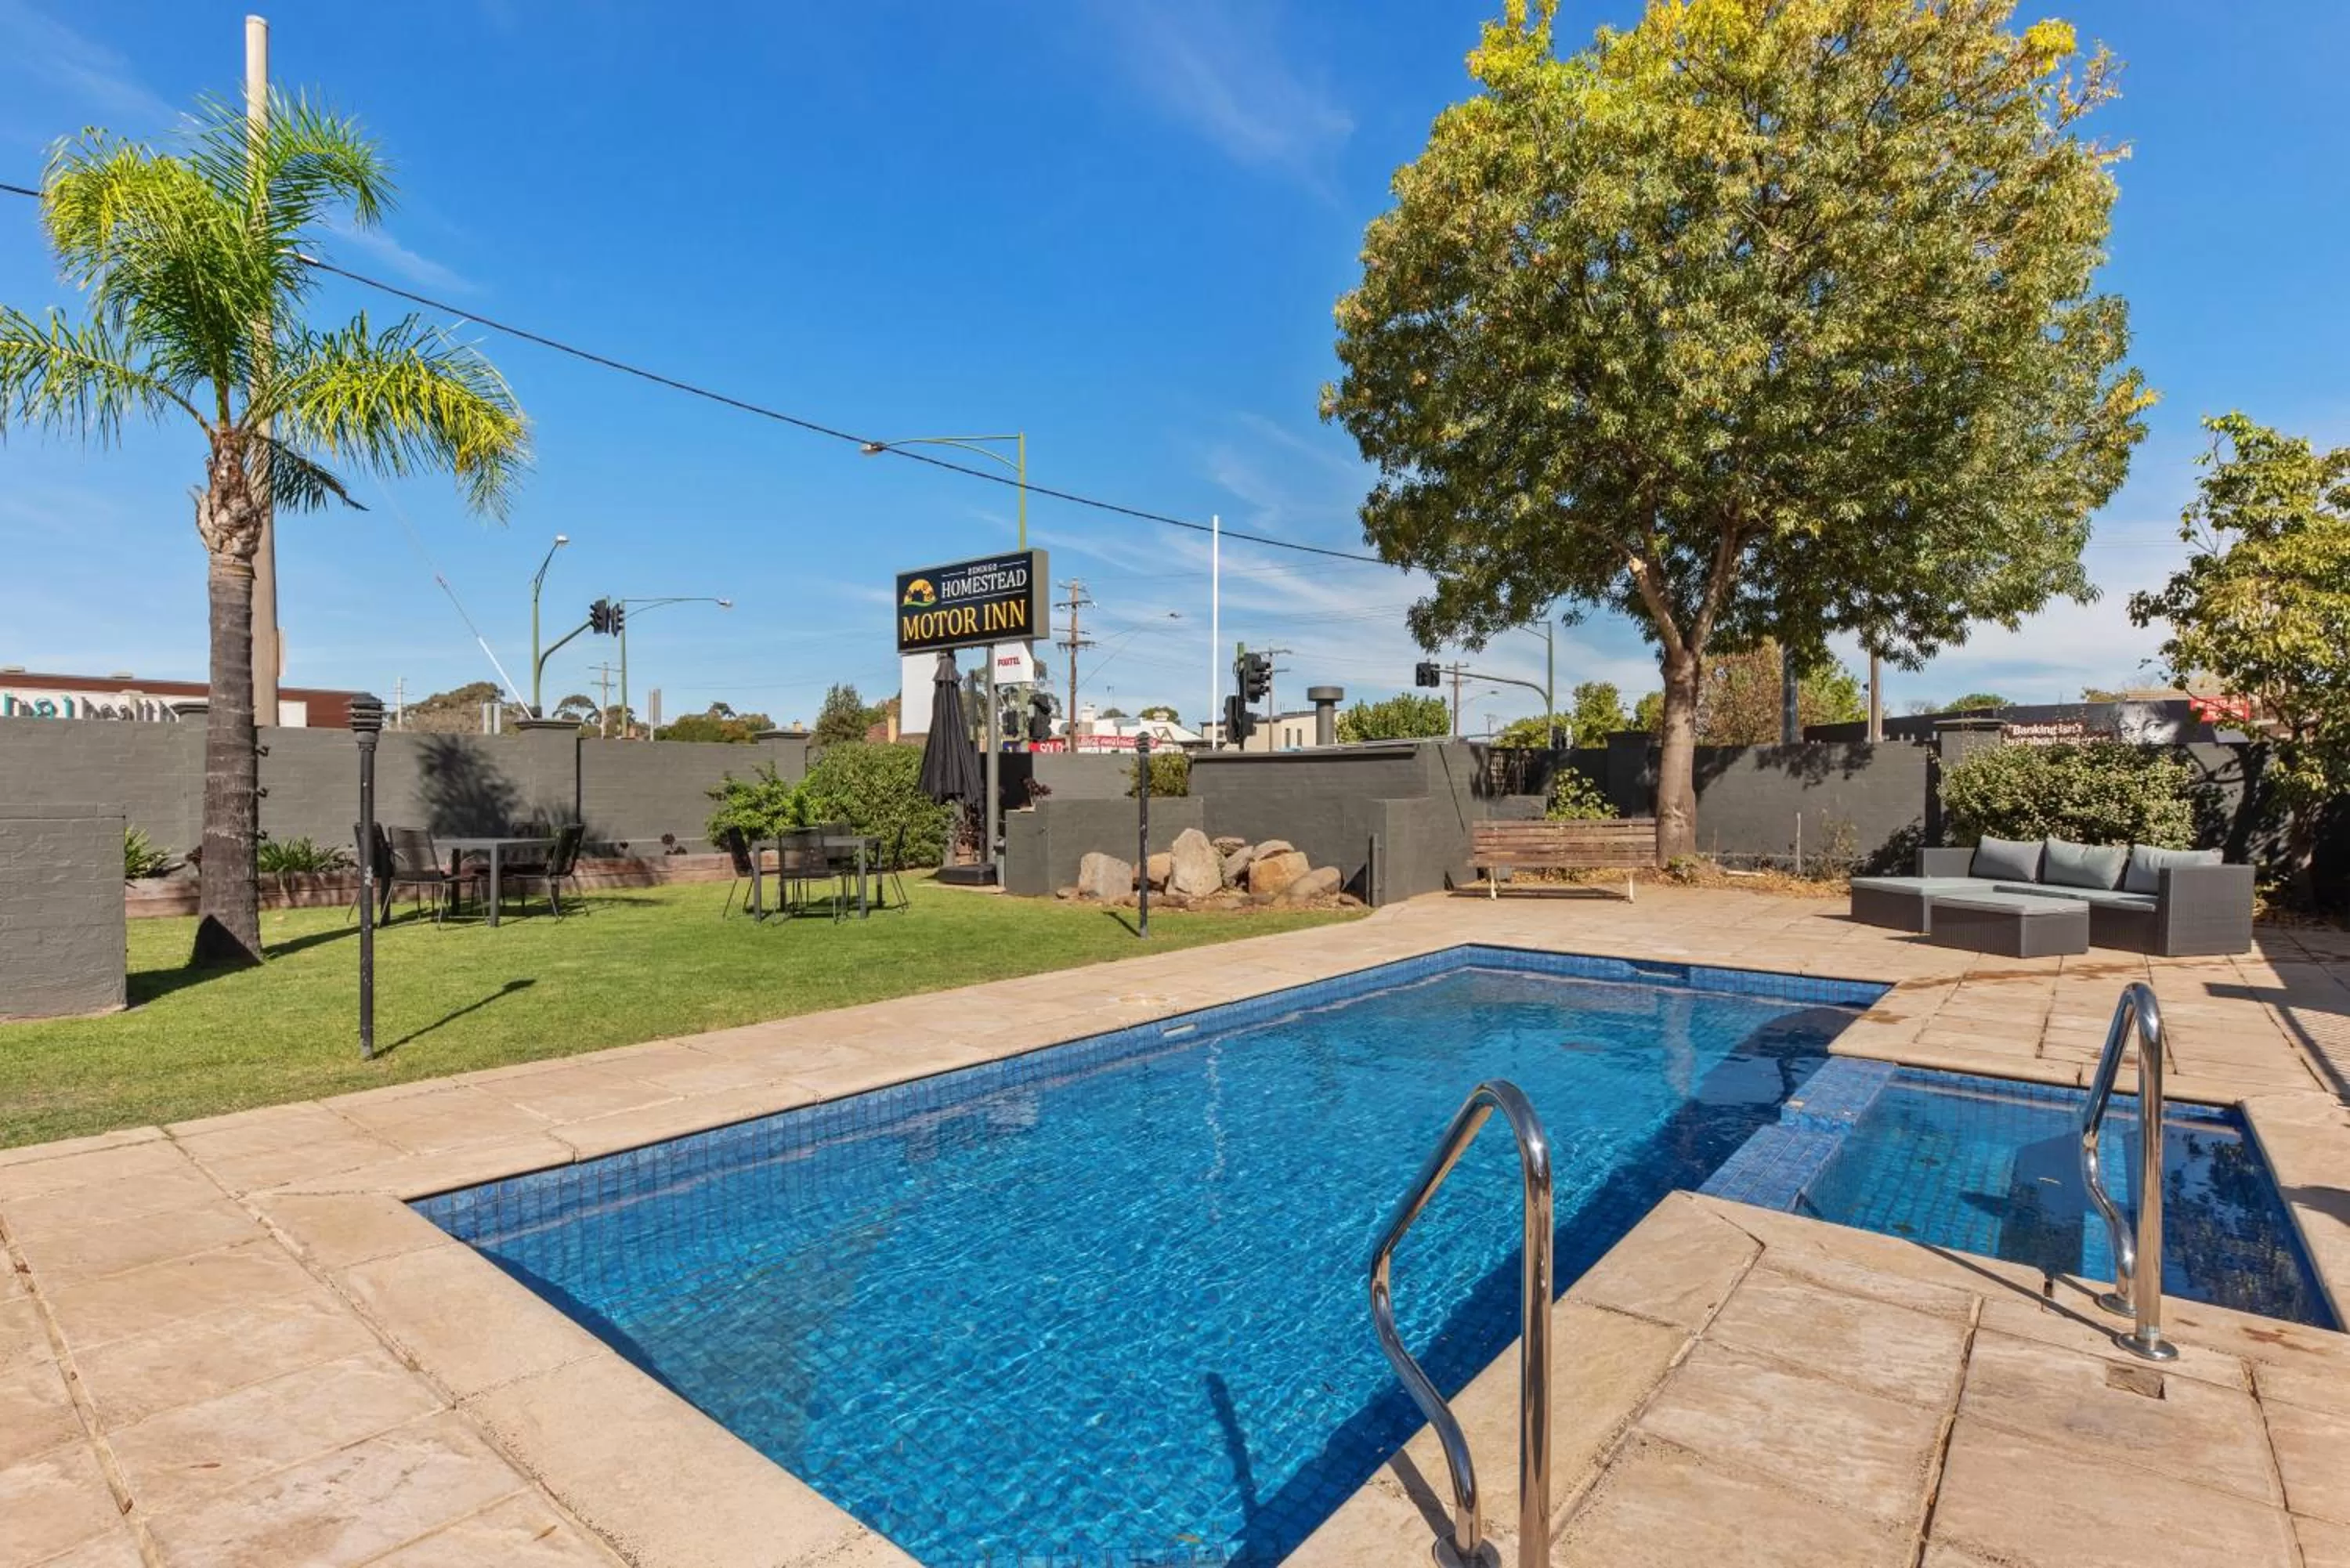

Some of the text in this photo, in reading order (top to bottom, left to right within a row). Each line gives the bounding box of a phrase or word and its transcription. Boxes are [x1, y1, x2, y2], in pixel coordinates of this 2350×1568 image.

[941, 569, 1027, 599] HOMESTEAD
[902, 599, 1025, 641] MOTOR INN
[2012, 724, 2058, 735] Banking
